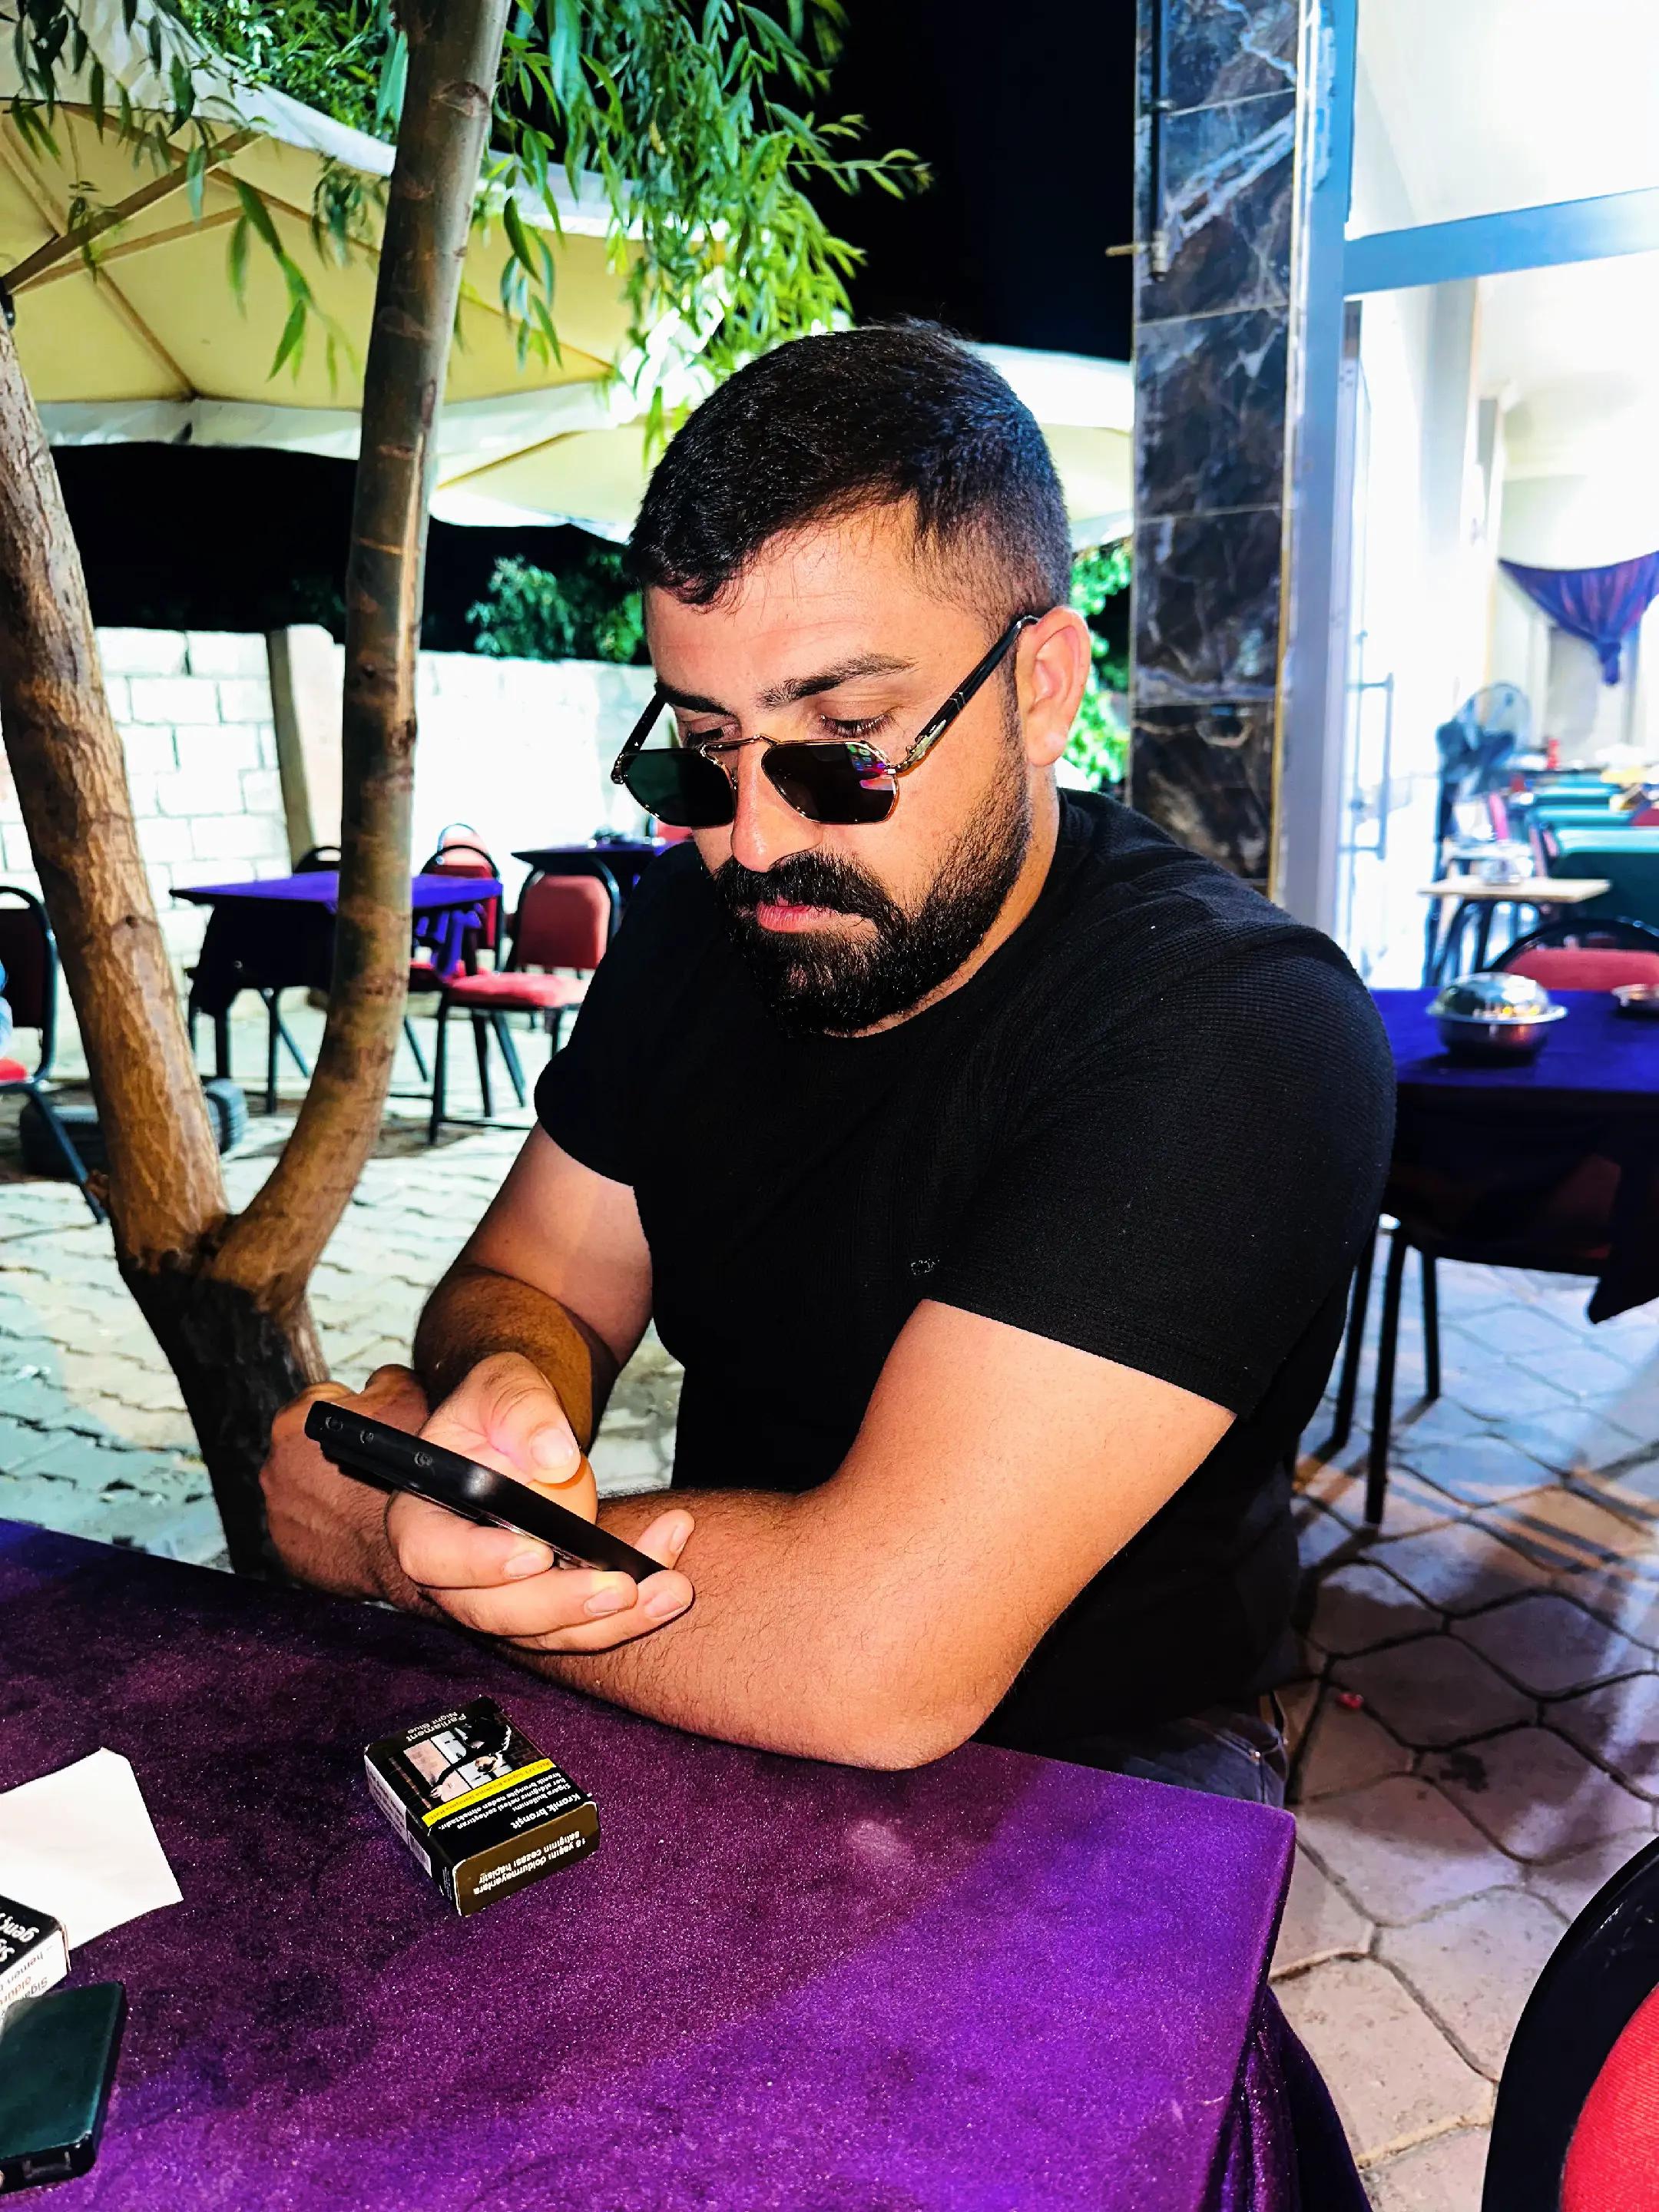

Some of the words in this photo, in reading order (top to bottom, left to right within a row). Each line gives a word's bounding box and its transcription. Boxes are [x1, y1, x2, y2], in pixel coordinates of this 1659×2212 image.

[406, 1714, 466, 1741] Parliament
[547, 1783, 571, 1796] Sigara
[546, 1793, 581, 1813] Kronik
[510, 1808, 548, 1829] bronşit
